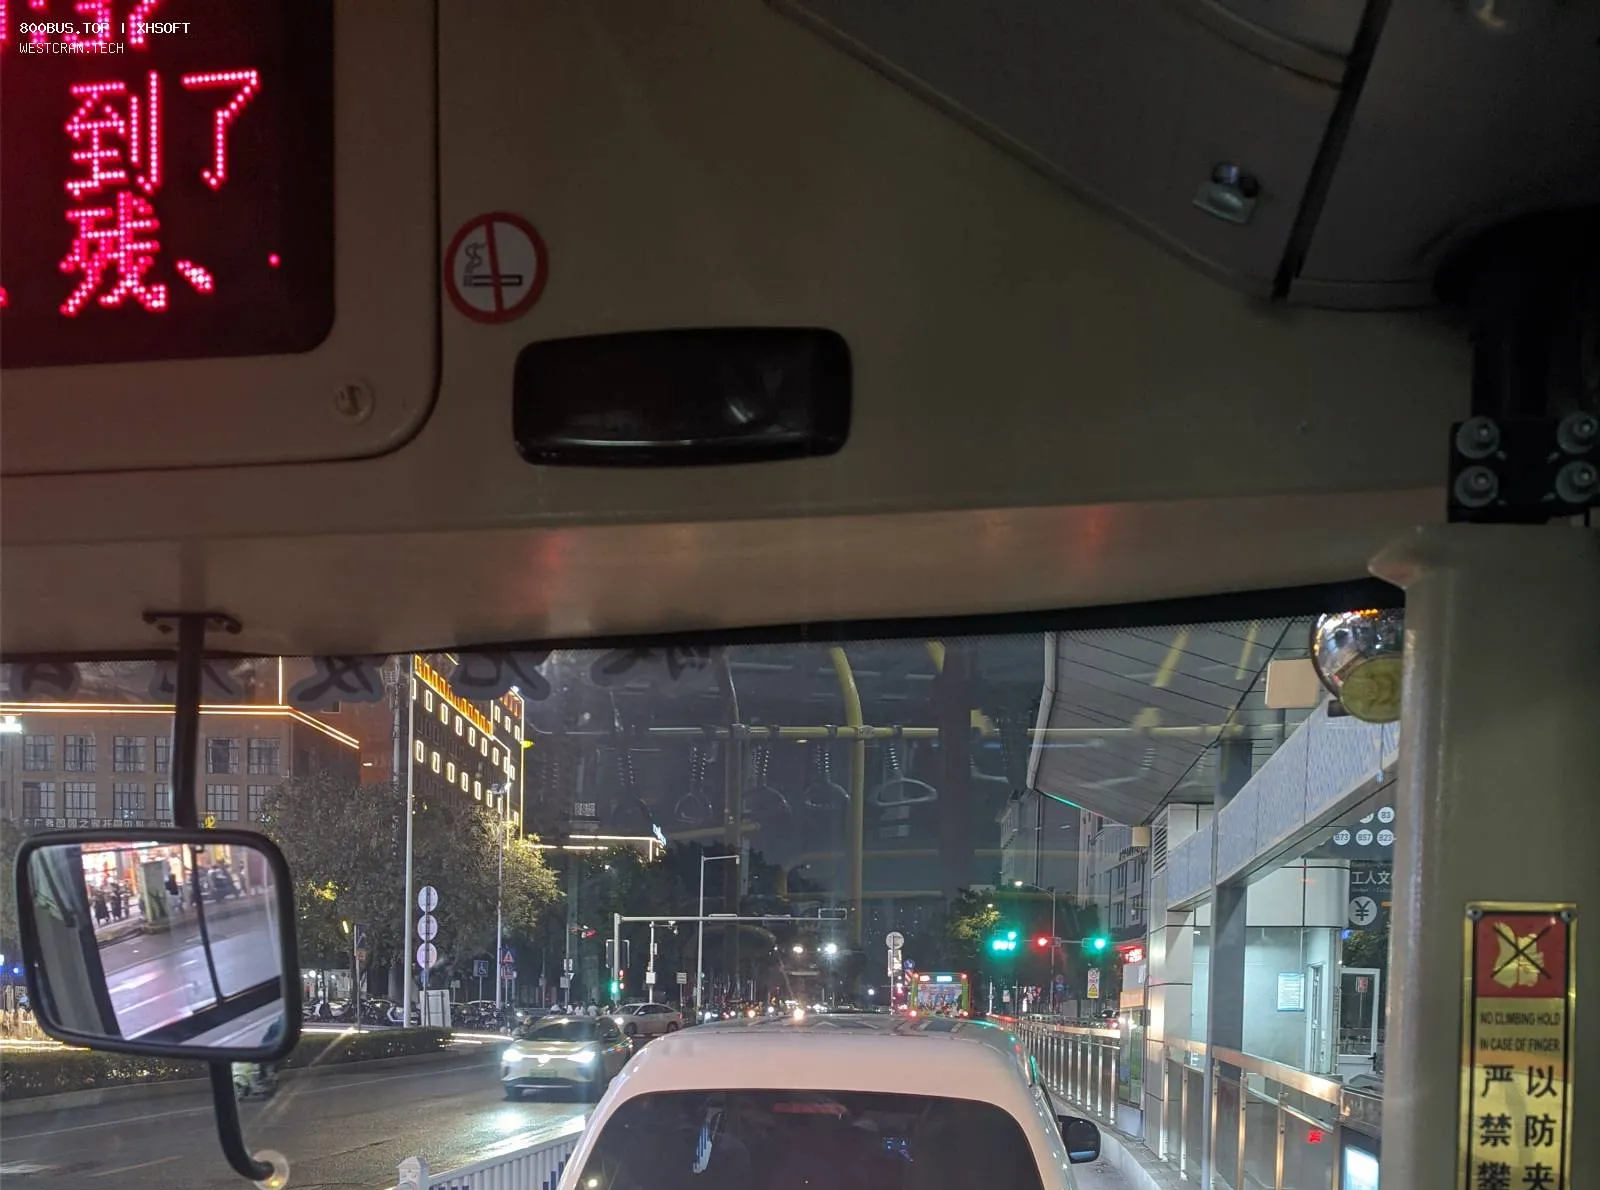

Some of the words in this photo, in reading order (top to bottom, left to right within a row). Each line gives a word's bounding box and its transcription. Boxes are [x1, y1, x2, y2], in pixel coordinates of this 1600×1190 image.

[64, 68, 260, 196] 到了
[1480, 1011, 1493, 1025] NO
[1480, 1037, 1489, 1050] IN
[1490, 1037, 1513, 1051] CASE
[1515, 1037, 1526, 1051] OF
[1529, 1037, 1560, 1052] FINGER
